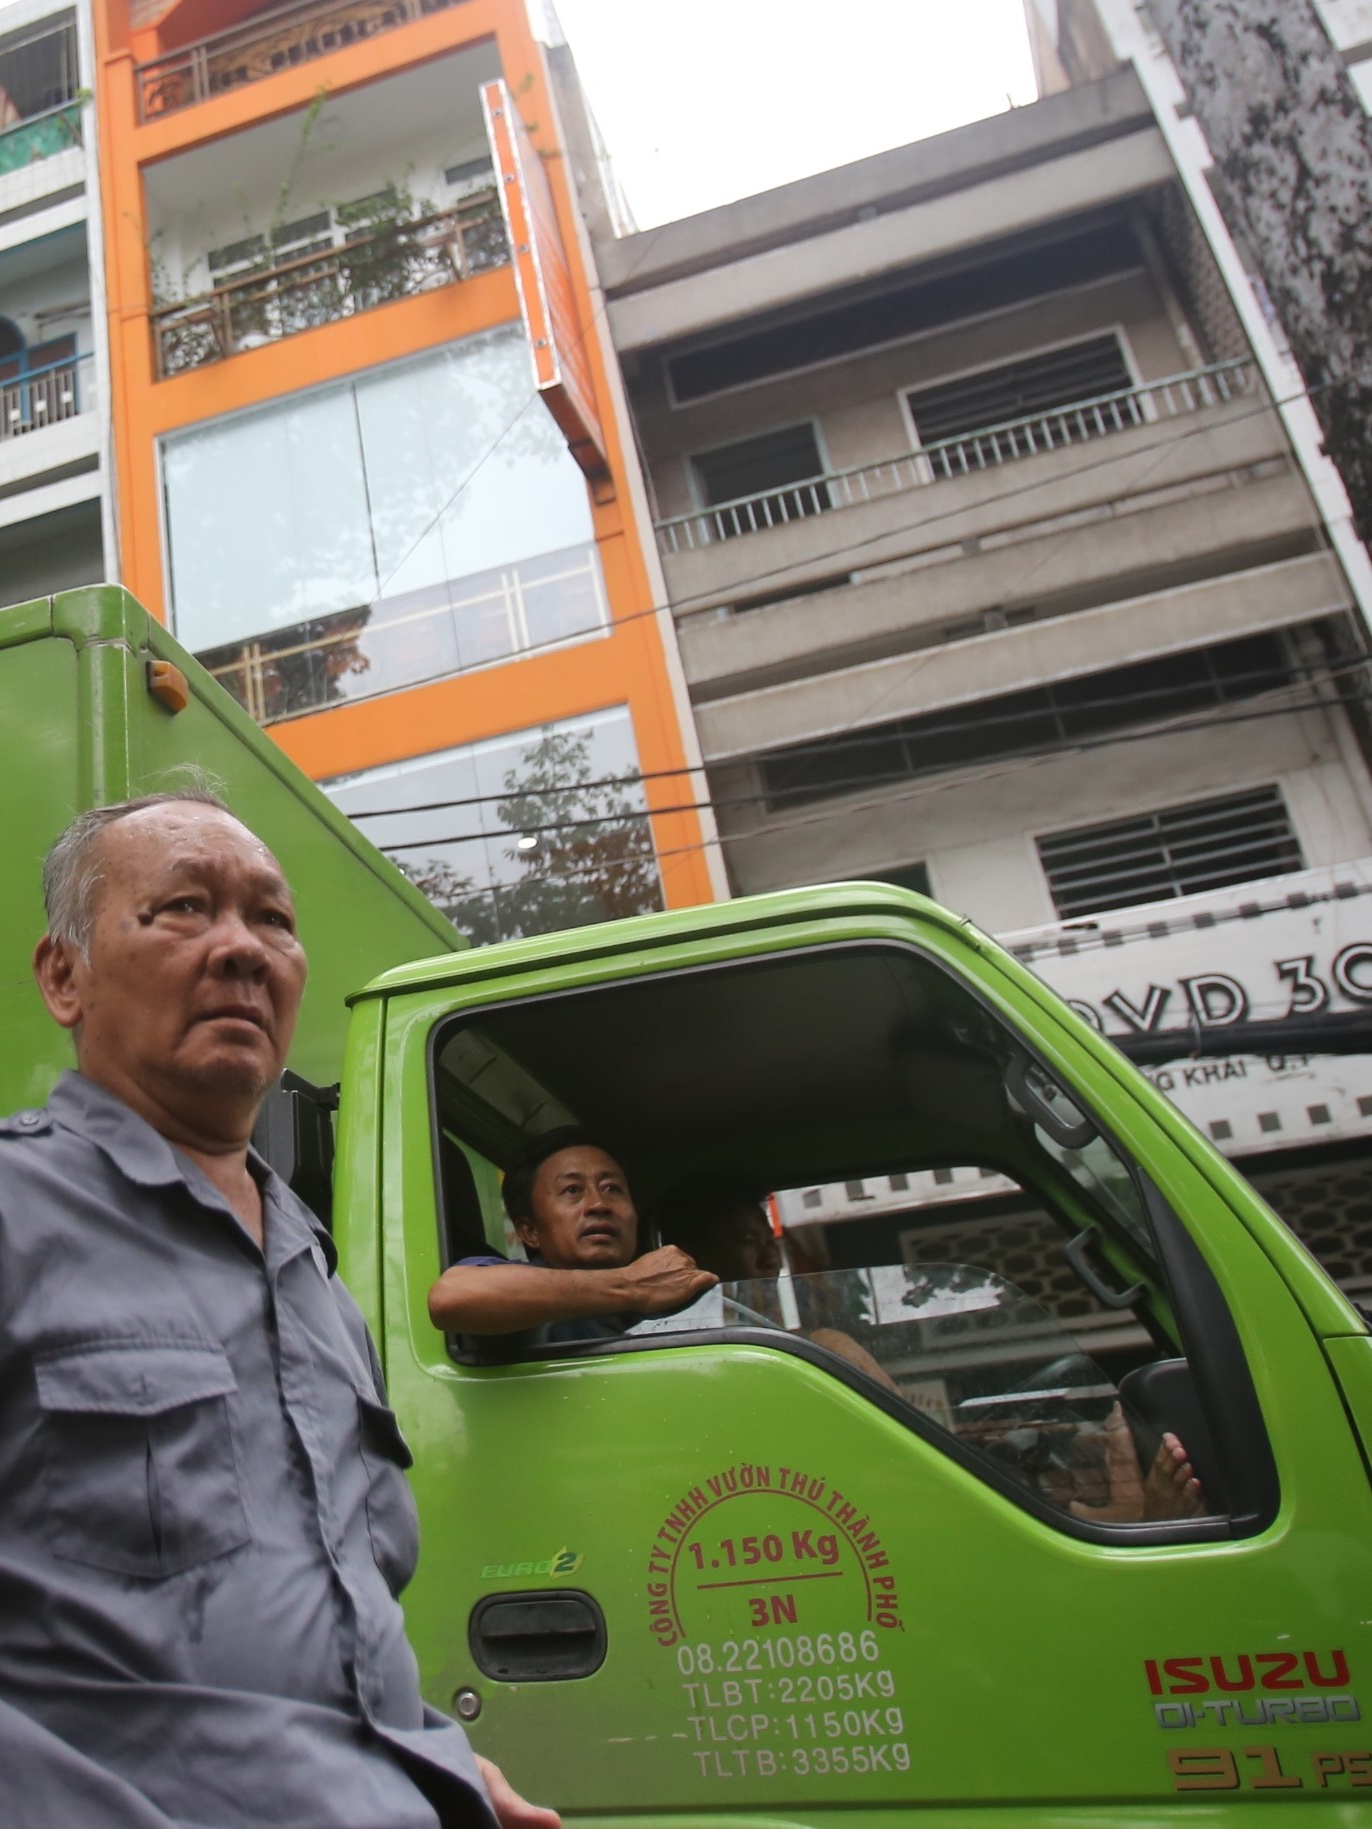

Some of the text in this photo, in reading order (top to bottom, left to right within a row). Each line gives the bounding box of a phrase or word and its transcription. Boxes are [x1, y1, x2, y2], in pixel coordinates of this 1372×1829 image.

[1183, 1059, 1248, 1087] KHAI
[647, 1463, 905, 1647] CÔNG TY TNHH VƯỜN THÚ THÀNH PHỐ
[689, 1529, 840, 1570] 1.150 Kg
[748, 1594, 798, 1627] 3N
[678, 1630, 879, 1676] 08.22108686
[1144, 1650, 1351, 1695] ISUZU
[1154, 1695, 1361, 1729] DI-TURBO
[1167, 1746, 1304, 1791] 91
